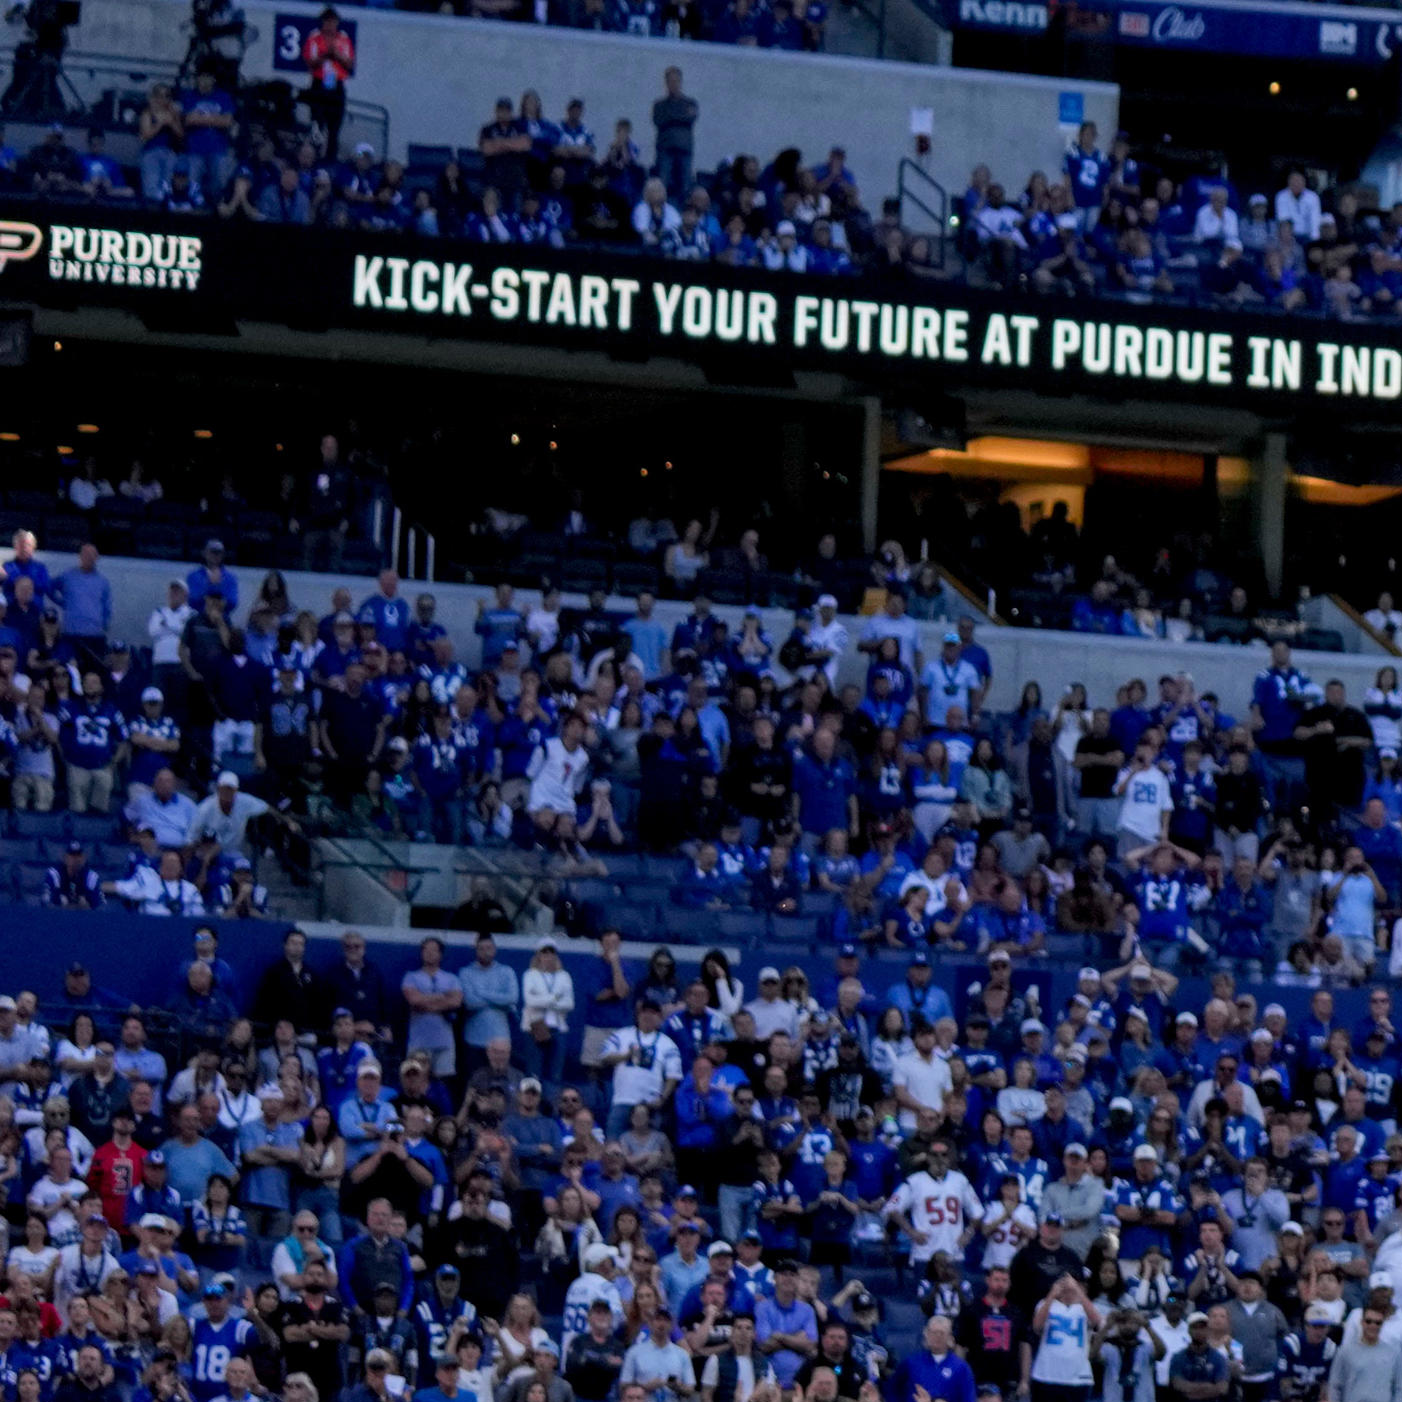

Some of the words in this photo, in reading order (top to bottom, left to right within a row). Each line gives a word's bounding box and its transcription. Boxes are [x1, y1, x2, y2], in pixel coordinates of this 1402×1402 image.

[49, 225, 202, 271] PURDUE
[49, 258, 201, 290] UNIVERSITY
[354, 255, 640, 329] KICK-START
[653, 282, 777, 343] YOUR
[794, 296, 969, 361] FUTURE
[982, 313, 1039, 366] AT
[1052, 319, 1233, 384] PURDUE
[1247, 337, 1301, 390] IN
[926, 1198, 960, 1225] 59
[982, 1320, 1013, 1351] 51
[1047, 1314, 1085, 1347] 24
[195, 1342, 230, 1382] 18
